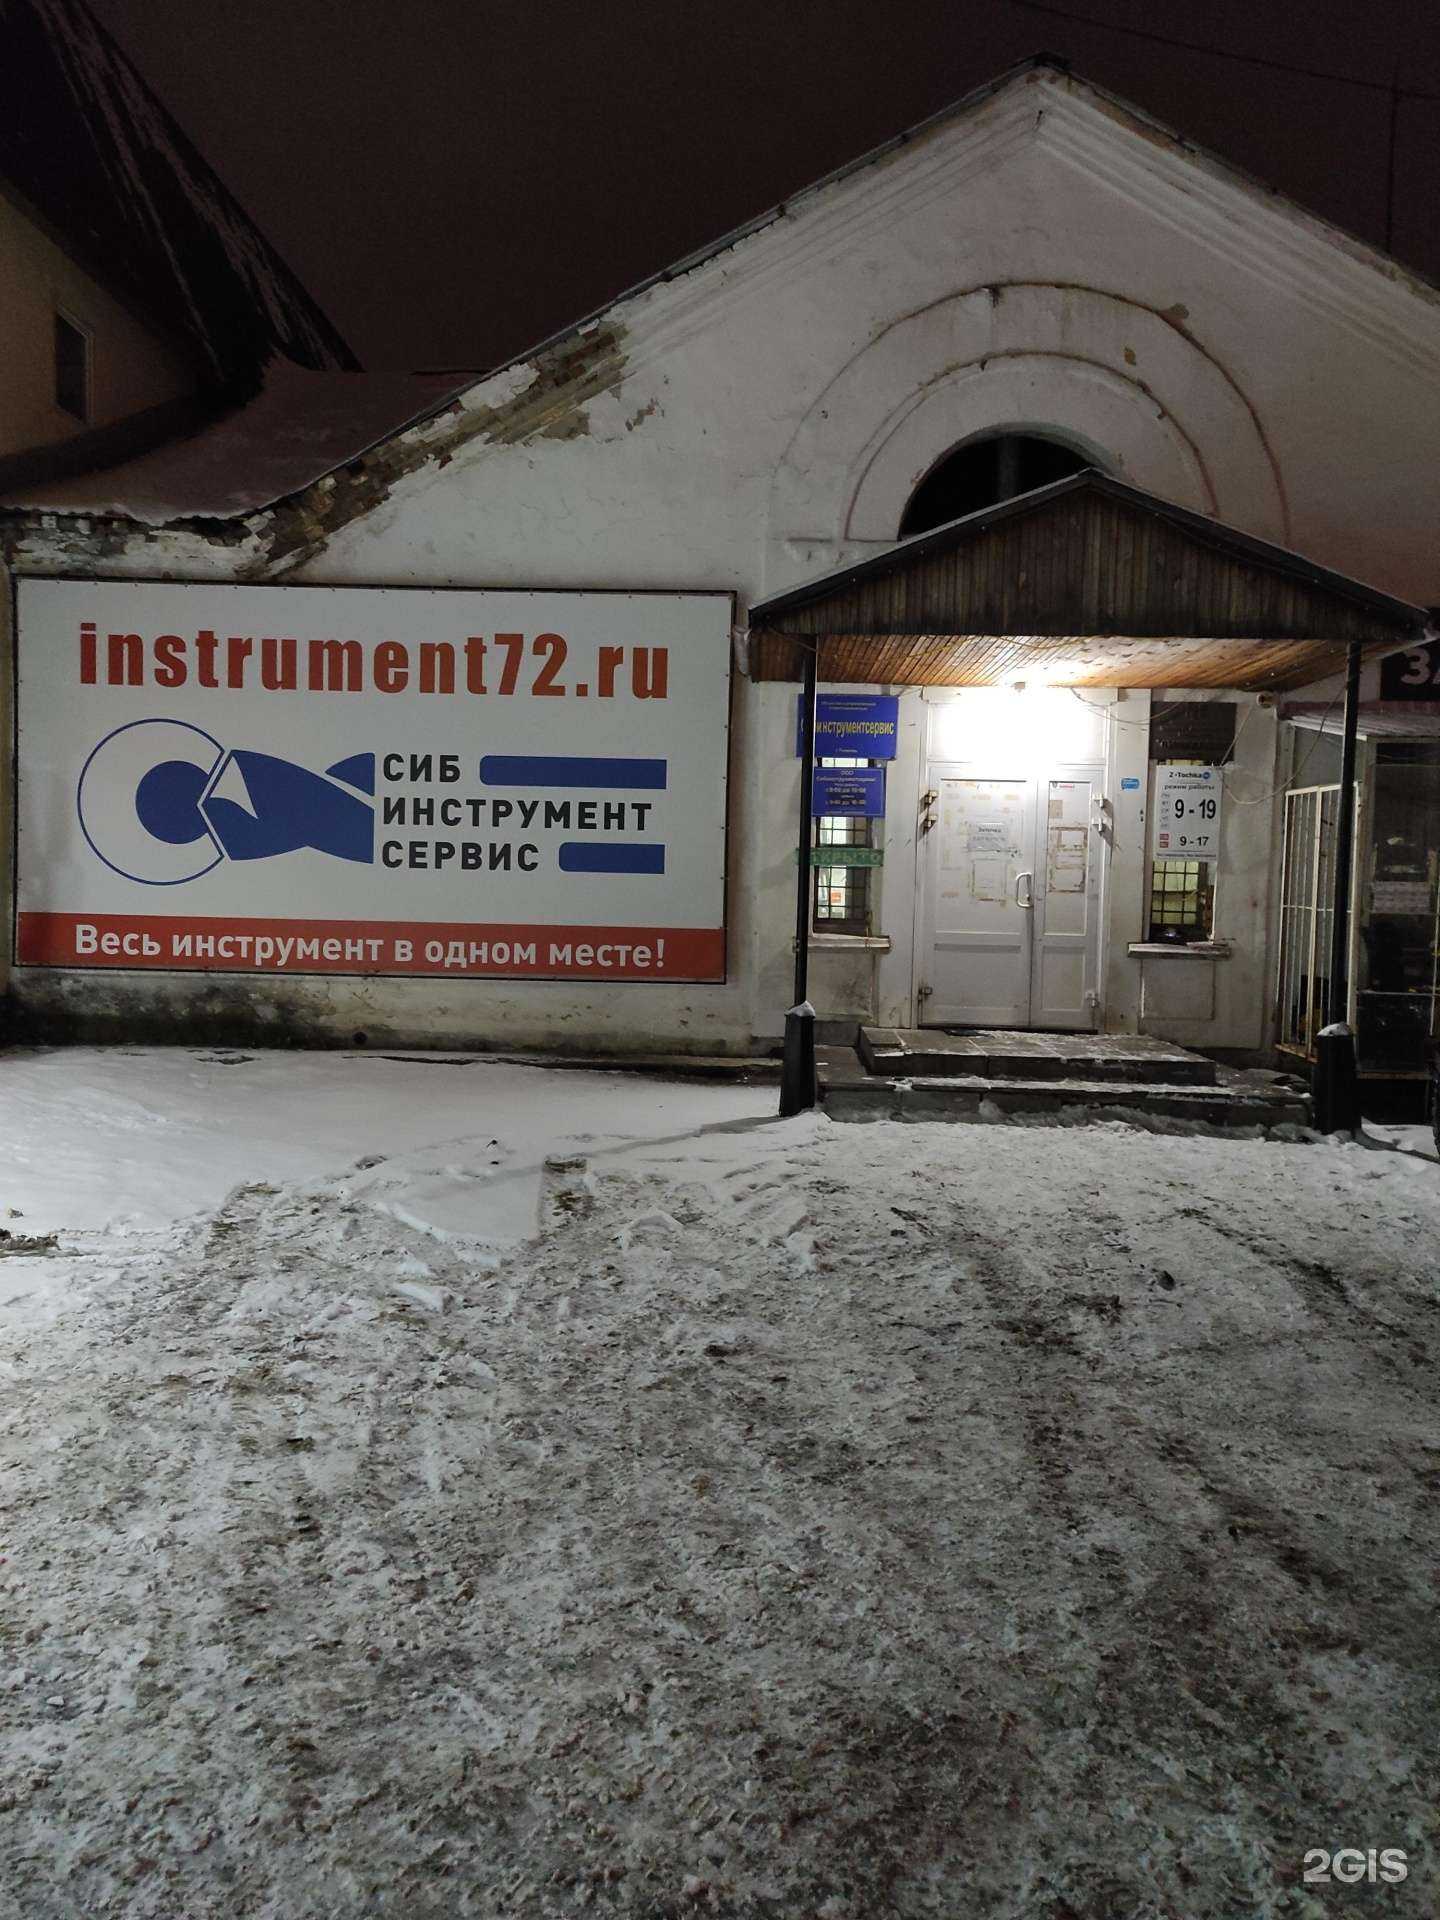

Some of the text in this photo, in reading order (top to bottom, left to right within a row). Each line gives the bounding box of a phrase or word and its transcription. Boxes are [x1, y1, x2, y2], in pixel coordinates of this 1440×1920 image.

[80, 622, 668, 699] instrument72.ru
[801, 719, 895, 738] инструментсервис
[383, 753, 461, 783] СИБ
[383, 797, 652, 831] ИНСТРУМЕНТ
[382, 840, 539, 872] СЕРВИС
[75, 924, 665, 969] Весь инструмент в одном месте!
